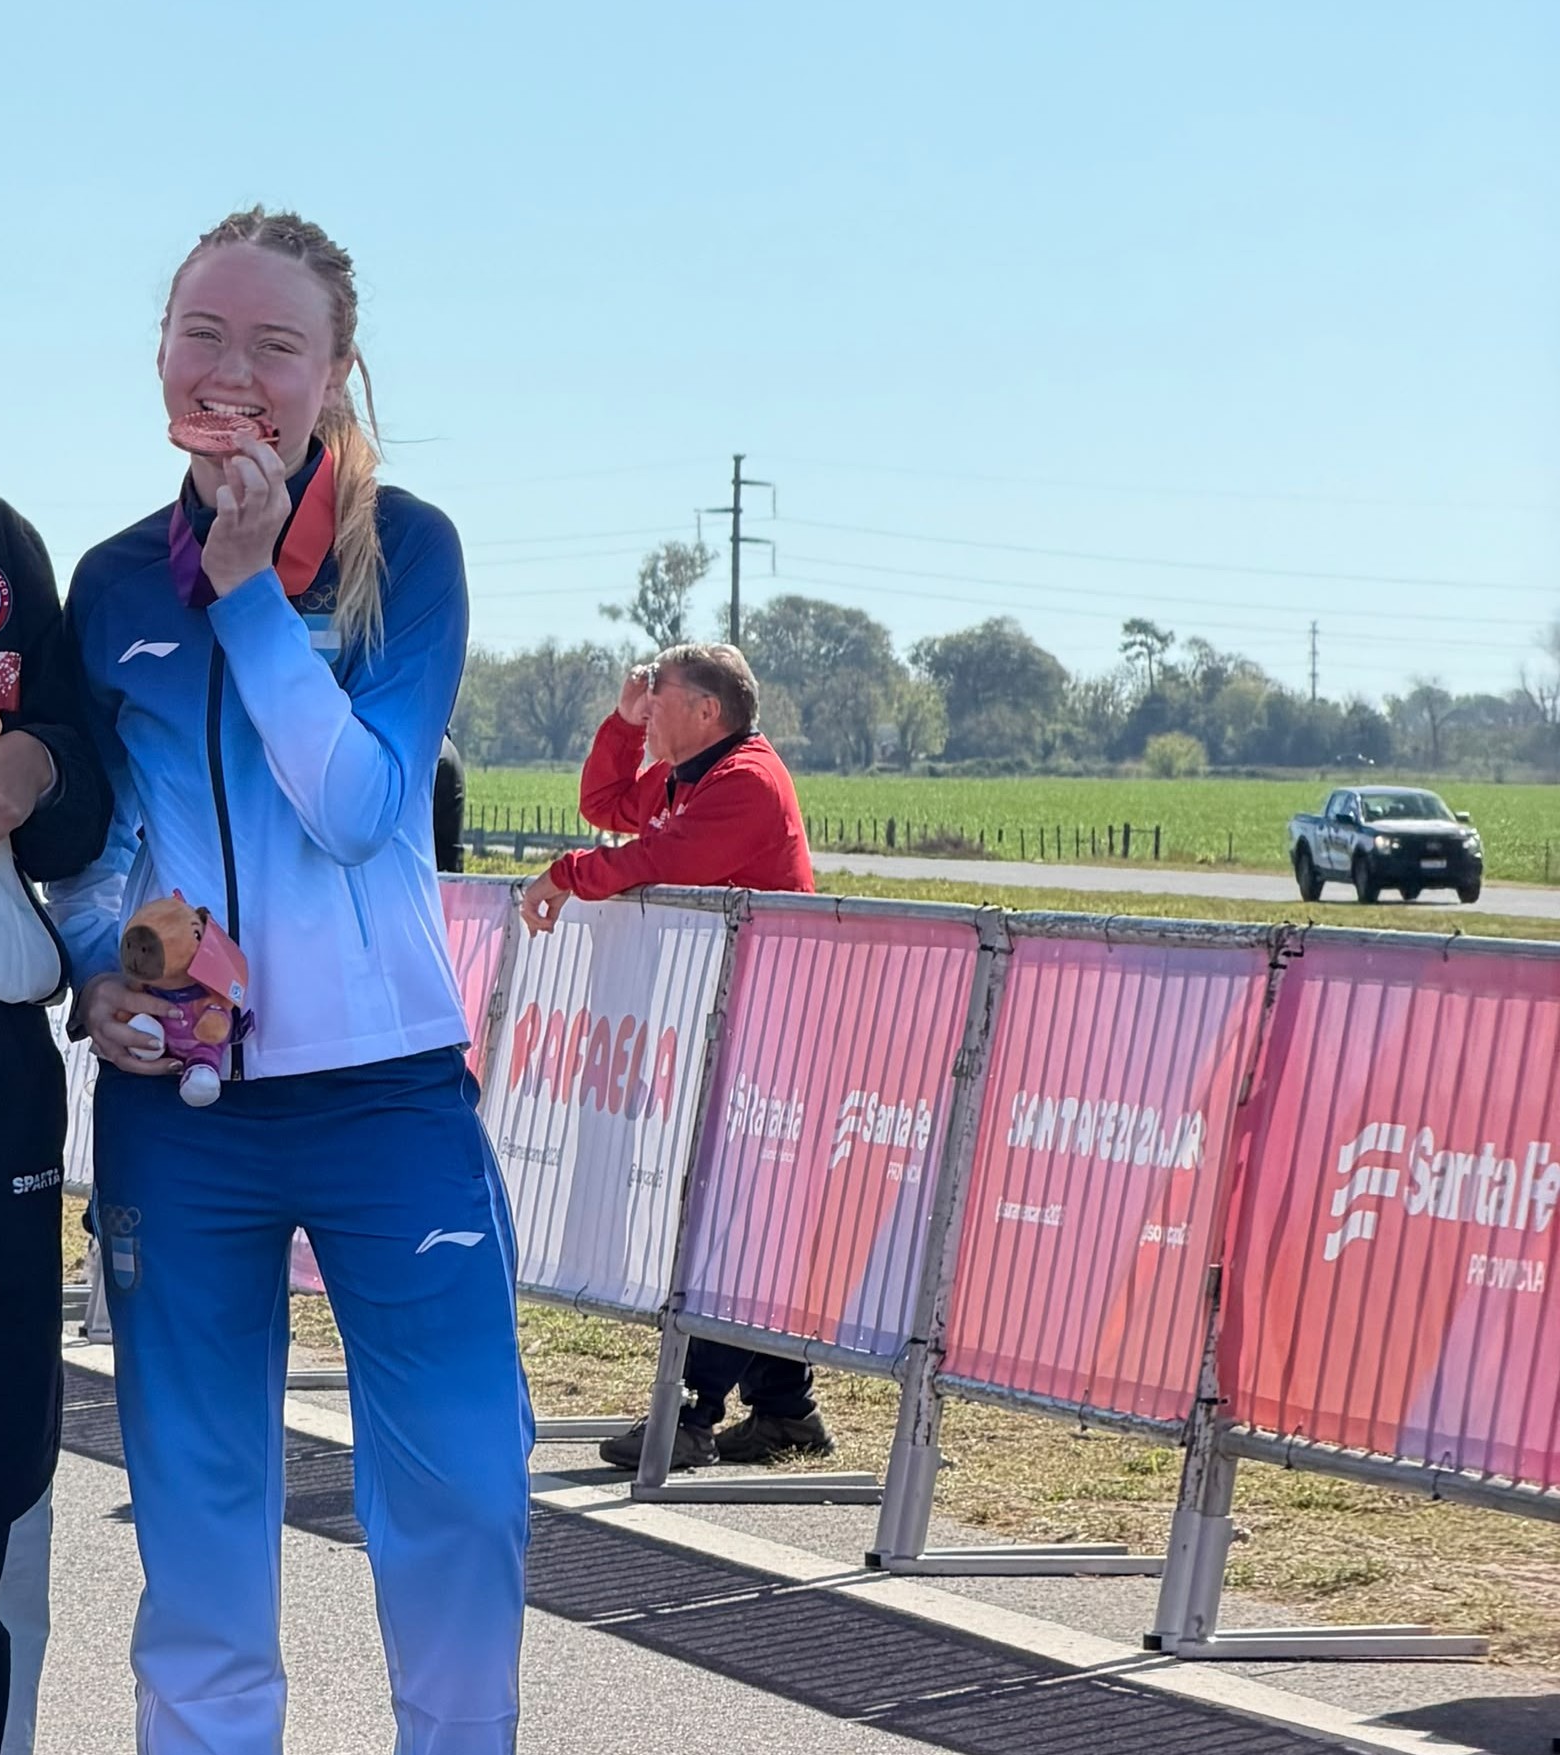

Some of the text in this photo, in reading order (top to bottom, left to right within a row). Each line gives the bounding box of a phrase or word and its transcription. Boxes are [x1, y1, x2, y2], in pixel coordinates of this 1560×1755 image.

[510, 1001, 678, 1125] RAFAELA
[861, 1091, 932, 1151] Santa Fe
[1404, 1125, 1560, 1233] Santa Fe
